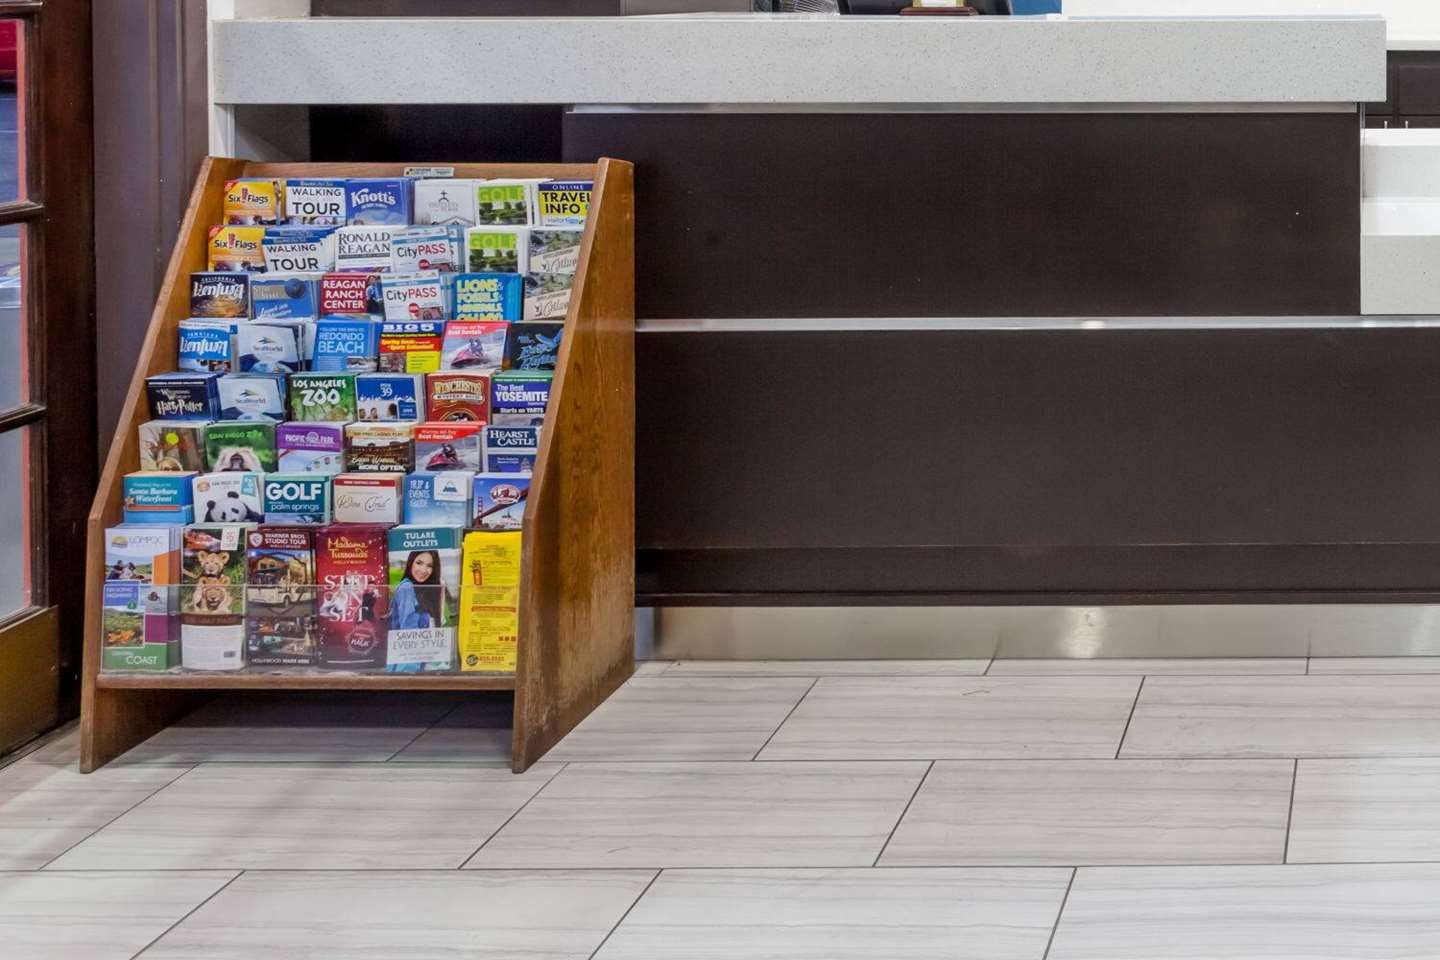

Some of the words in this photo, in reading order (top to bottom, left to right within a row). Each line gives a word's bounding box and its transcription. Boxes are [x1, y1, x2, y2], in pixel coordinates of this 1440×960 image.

[292, 188, 341, 196] WALKING
[478, 188, 524, 201] GOLF
[228, 194, 240, 202] Six
[247, 194, 268, 204] Flags
[351, 188, 396, 208] Knott's
[292, 202, 340, 215] TOUR
[545, 204, 580, 214] INFO
[338, 232, 390, 244] RONALD
[214, 240, 227, 248] Six
[235, 240, 257, 250] Flags
[267, 244, 317, 253] WALKING
[338, 243, 391, 253] REAGAN
[397, 243, 446, 258] CityPASS
[271, 257, 319, 271] TOUR
[323, 280, 366, 289] REAGAN
[325, 290, 363, 299] RANCH
[386, 287, 438, 302] CityPASS
[324, 300, 364, 309] CENTER
[383, 324, 418, 332] BIG
[420, 323, 434, 332] 5
[319, 332, 364, 340] REDONDO
[318, 341, 364, 353] BEACH
[293, 380, 308, 388] LOS
[309, 379, 346, 388] ANGELES
[301, 389, 340, 406] ZOO
[381, 388, 392, 397] 39
[495, 392, 548, 401] YOSEMITE
[490, 430, 529, 438] HEARST
[497, 438, 535, 446] CASTLE
[266, 483, 322, 500] GOLF
[292, 504, 320, 512] springs
[328, 537, 368, 549] Madame
[328, 548, 368, 558] Tussauds
[329, 607, 369, 622] SET
[397, 631, 432, 640] SAVINGS
[393, 641, 418, 649] EVERY
[127, 656, 157, 664] COAST
